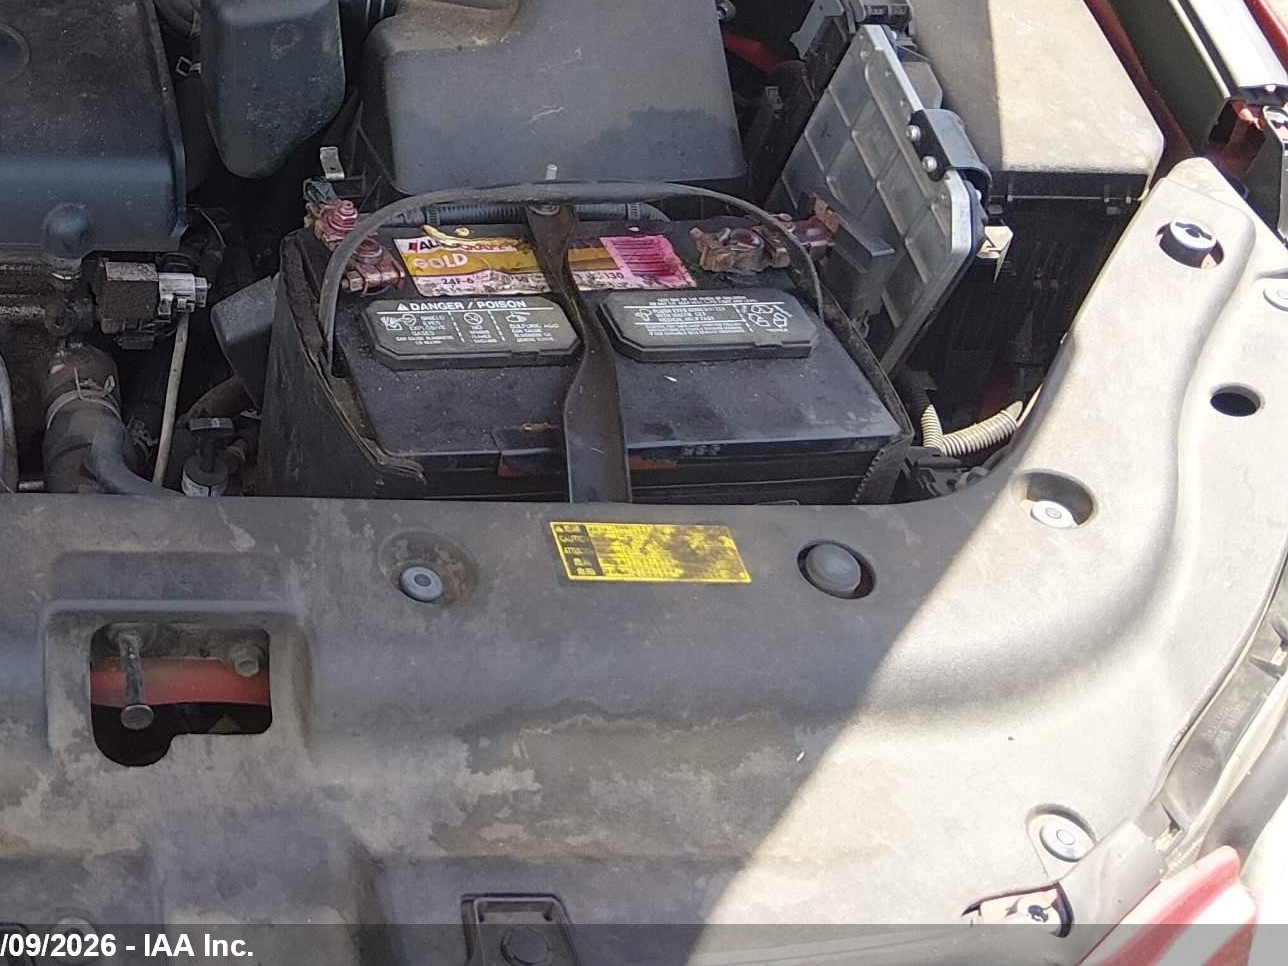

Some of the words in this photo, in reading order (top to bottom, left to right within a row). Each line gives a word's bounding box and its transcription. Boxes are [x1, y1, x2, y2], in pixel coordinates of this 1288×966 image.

[412, 252, 469, 269] GOLD
[411, 301, 464, 311] DANGER
[478, 300, 528, 309] POISON
